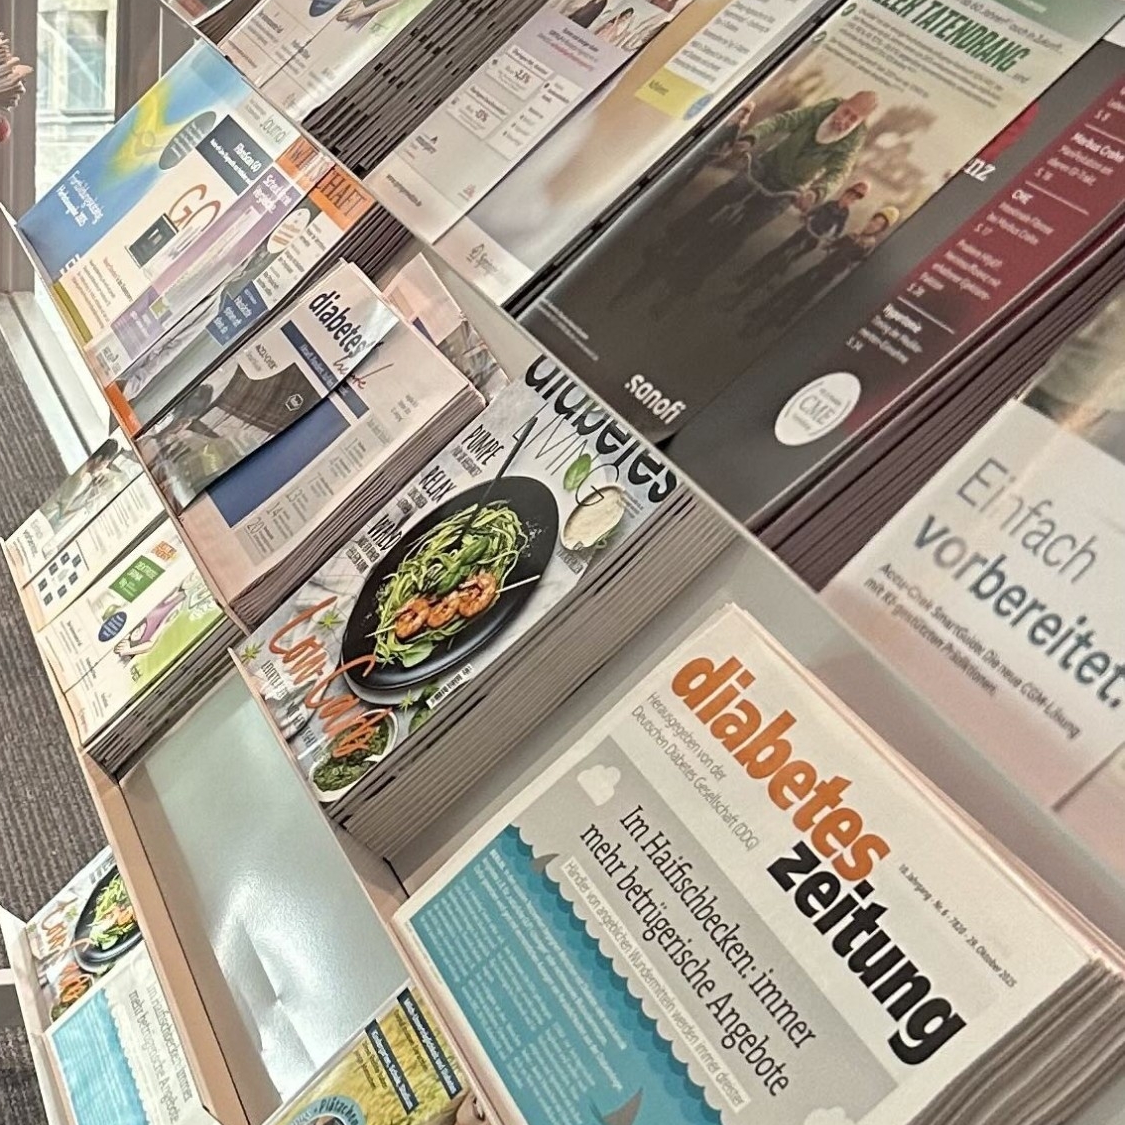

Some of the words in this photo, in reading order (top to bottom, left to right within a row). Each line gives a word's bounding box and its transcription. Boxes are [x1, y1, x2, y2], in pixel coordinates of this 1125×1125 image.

[909, 0, 1030, 74] TATENDRANG
[623, 373, 687, 426] sanofi
[797, 394, 836, 424] CME
[460, 422, 504, 468] PUMPE
[416, 463, 458, 506] RELAX
[364, 513, 406, 554] WALD
[957, 457, 1096, 584] Einfach
[863, 576, 887, 597] mit
[916, 514, 1125, 709] vorbereitet.
[979, 649, 1002, 670] Die
[995, 662, 1023, 688] neue
[1017, 682, 1081, 739] CGM-Lösung
[645, 691, 702, 753] Herausgegeben
[694, 749, 714, 768] von
[707, 761, 730, 783] der
[630, 704, 671, 749] Deutschen
[662, 742, 701, 782] Diabetes
[691, 775, 740, 828] Gesellschaft
[671, 656, 891, 880] diabetes
[562, 859, 593, 895] Händler
[584, 890, 601, 909] von
[592, 903, 636, 954] angeblichen
[618, 804, 648, 842] Im
[639, 830, 758, 980] Haifischbecken:
[749, 969, 817, 1051] immer
[903, 871, 934, 901] Jahrgang
[973, 944, 1004, 973] Oktober
[578, 822, 626, 879] mehr
[614, 865, 714, 1000] betrügerische
[705, 993, 790, 1098] Angebote
[765, 840, 967, 1066] zeitung
[128, 988, 145, 1016] mehr
[627, 947, 677, 1013] Wundermitteln
[668, 1007, 701, 1046] werden
[692, 1040, 723, 1076] immer
[712, 1069, 748, 1109] dreister
